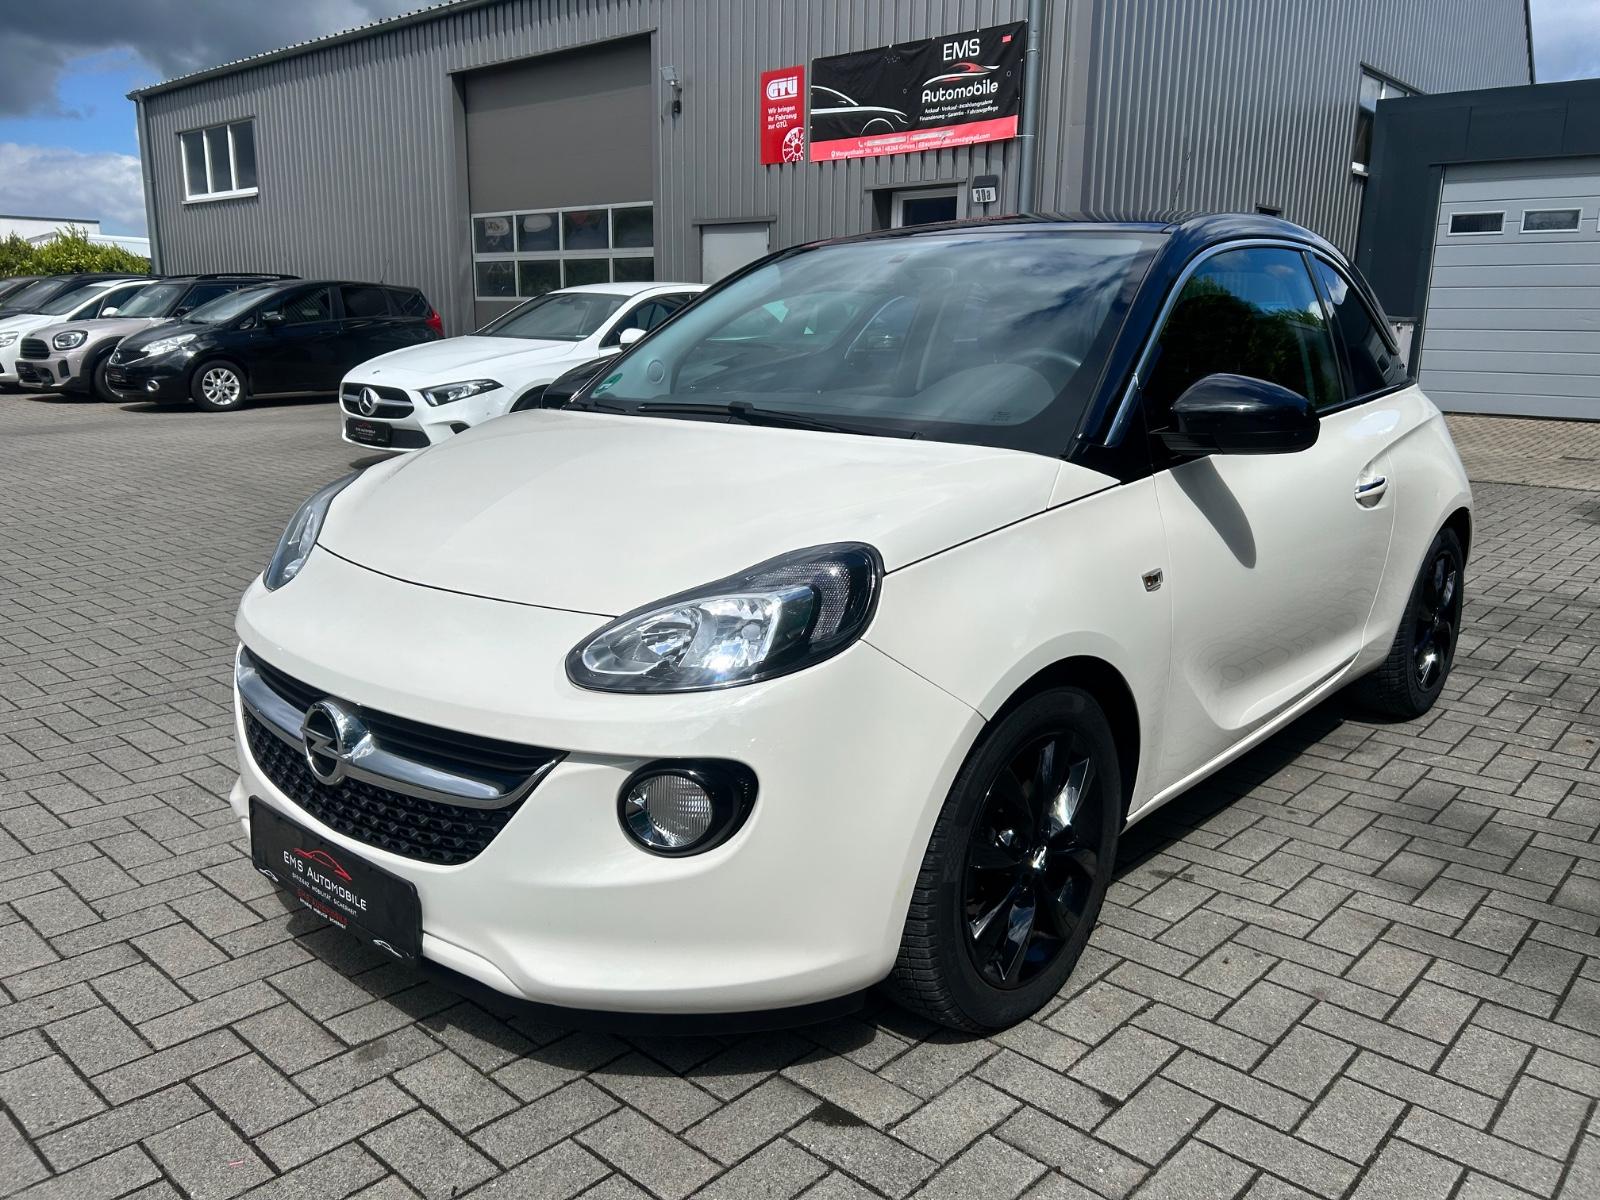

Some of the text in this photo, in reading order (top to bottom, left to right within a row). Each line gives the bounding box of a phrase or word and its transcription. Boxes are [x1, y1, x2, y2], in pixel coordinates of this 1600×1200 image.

[943, 38, 980, 60] EMS
[922, 79, 998, 103] Automobile
[775, 113, 797, 121] Fahrzeug
[284, 850, 304, 872] EMS
[307, 866, 367, 911] AUTOMOBILE
